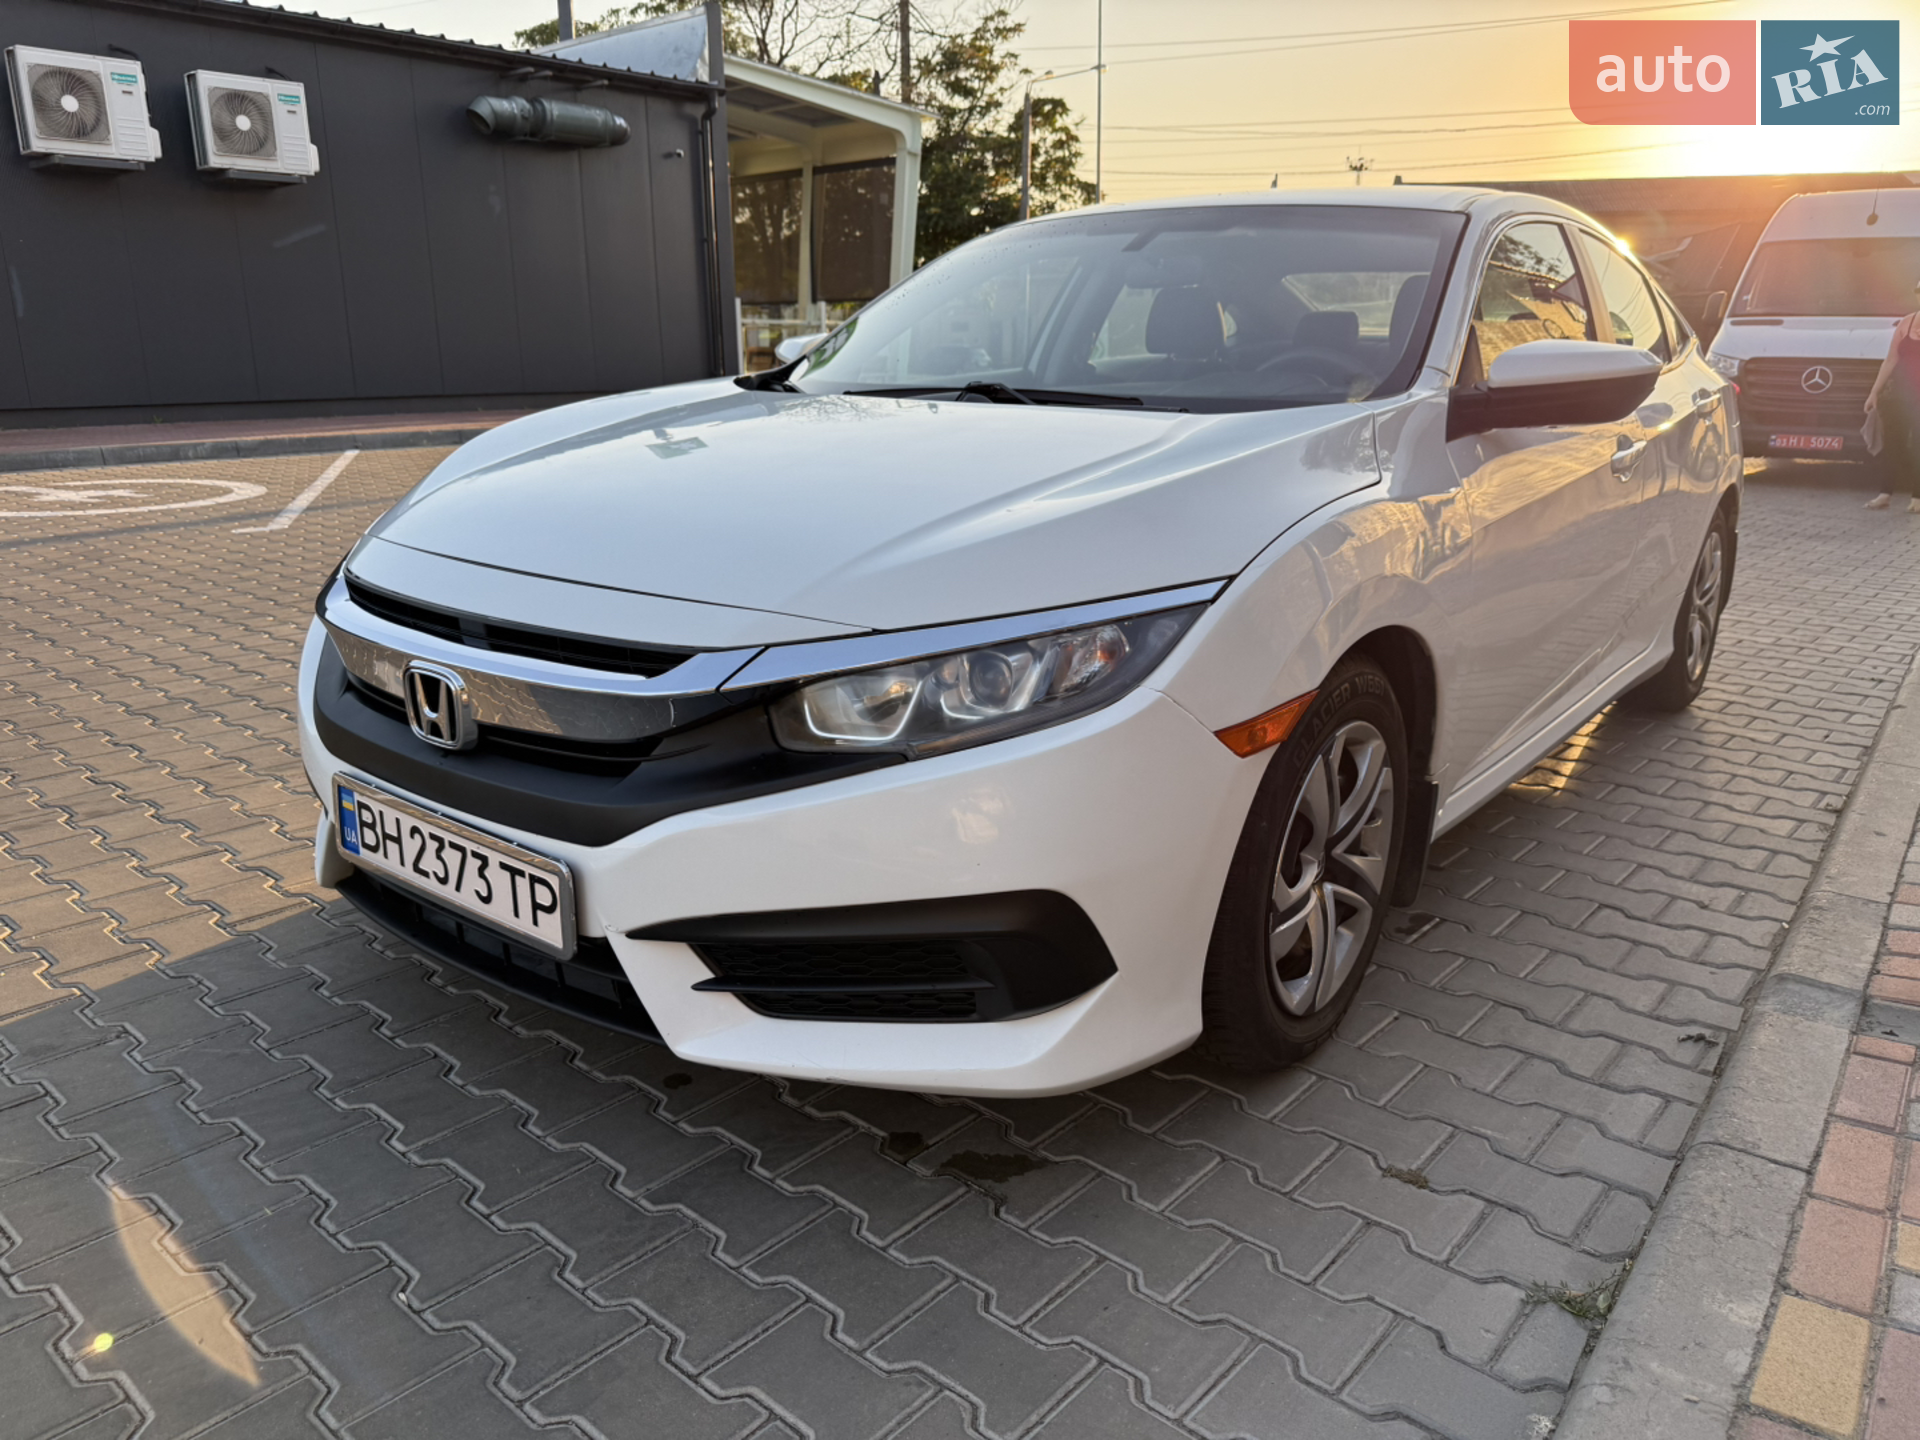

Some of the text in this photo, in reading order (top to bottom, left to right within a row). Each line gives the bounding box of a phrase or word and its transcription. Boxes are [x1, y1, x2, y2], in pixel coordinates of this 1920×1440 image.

[1810, 437, 1839, 449] 5074
[344, 826, 358, 845] UA
[356, 799, 558, 927] BH 2373 TP
